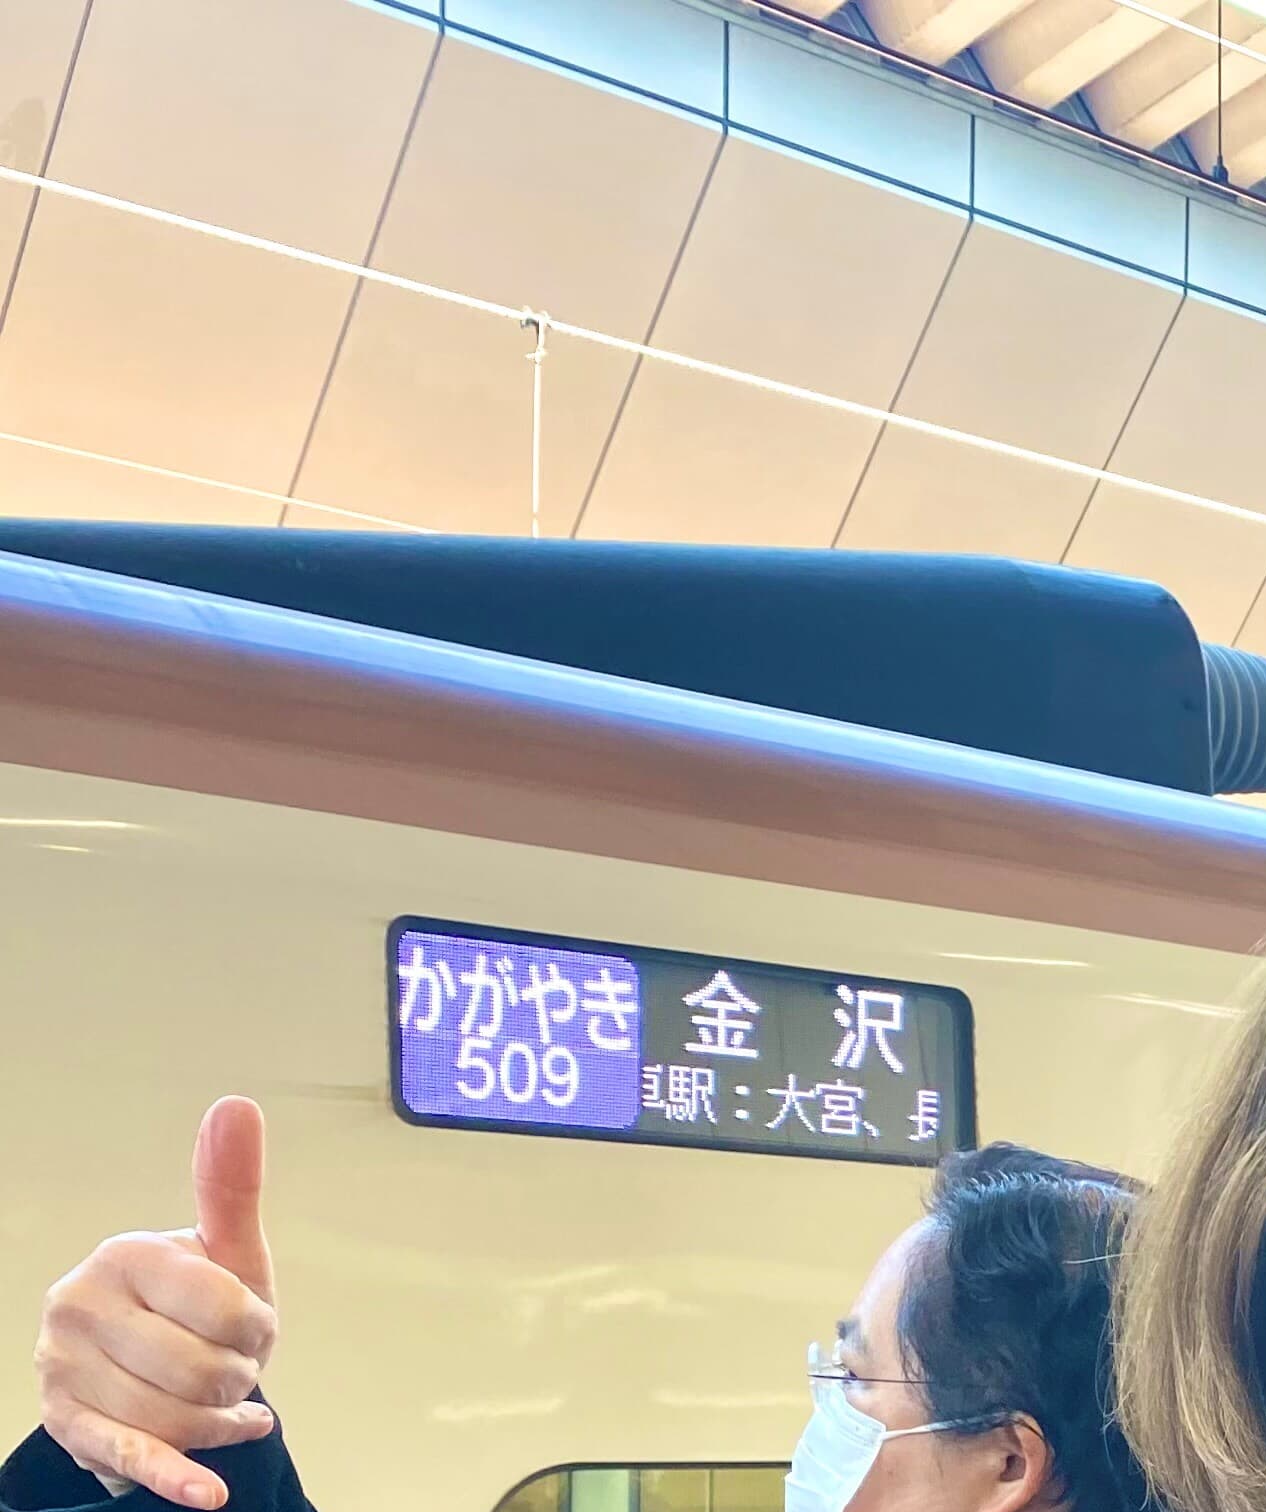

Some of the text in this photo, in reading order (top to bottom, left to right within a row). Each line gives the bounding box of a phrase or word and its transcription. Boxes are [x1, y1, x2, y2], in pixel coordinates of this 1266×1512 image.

[398, 946, 639, 1051] かがやき
[455, 1037, 579, 1107] 509
